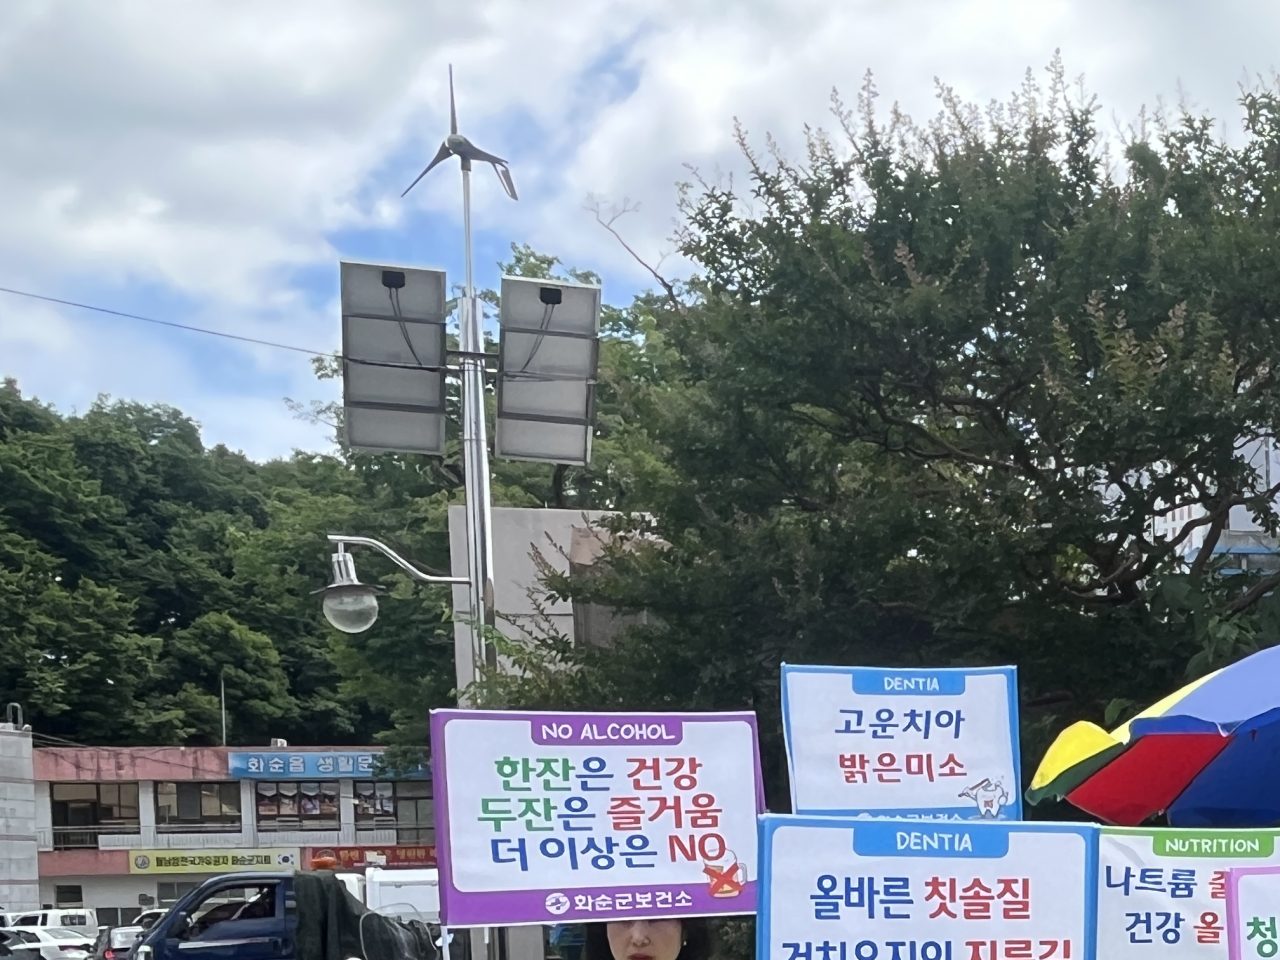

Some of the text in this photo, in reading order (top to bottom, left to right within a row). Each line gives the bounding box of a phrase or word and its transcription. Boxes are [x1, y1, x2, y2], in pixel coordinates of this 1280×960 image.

[884, 677, 940, 691] DENTIA
[541, 722, 676, 741] NO ALCOHOL
[834, 708, 966, 740] 고운치아
[494, 756, 703, 792] 한잔은 건강
[838, 752, 968, 784] 밝은미소
[477, 792, 723, 833] 두잔은 즐거움
[490, 832, 726, 872] 더 이상은 NO
[896, 831, 974, 852] DENTIA
[1165, 838, 1260, 854] NUTRITION
[809, 874, 1032, 921] 올바른 칫솔질
[1105, 865, 1198, 899] 나트륨
[574, 890, 693, 912] 화순군보건소
[1124, 911, 1225, 945] 건강 올
